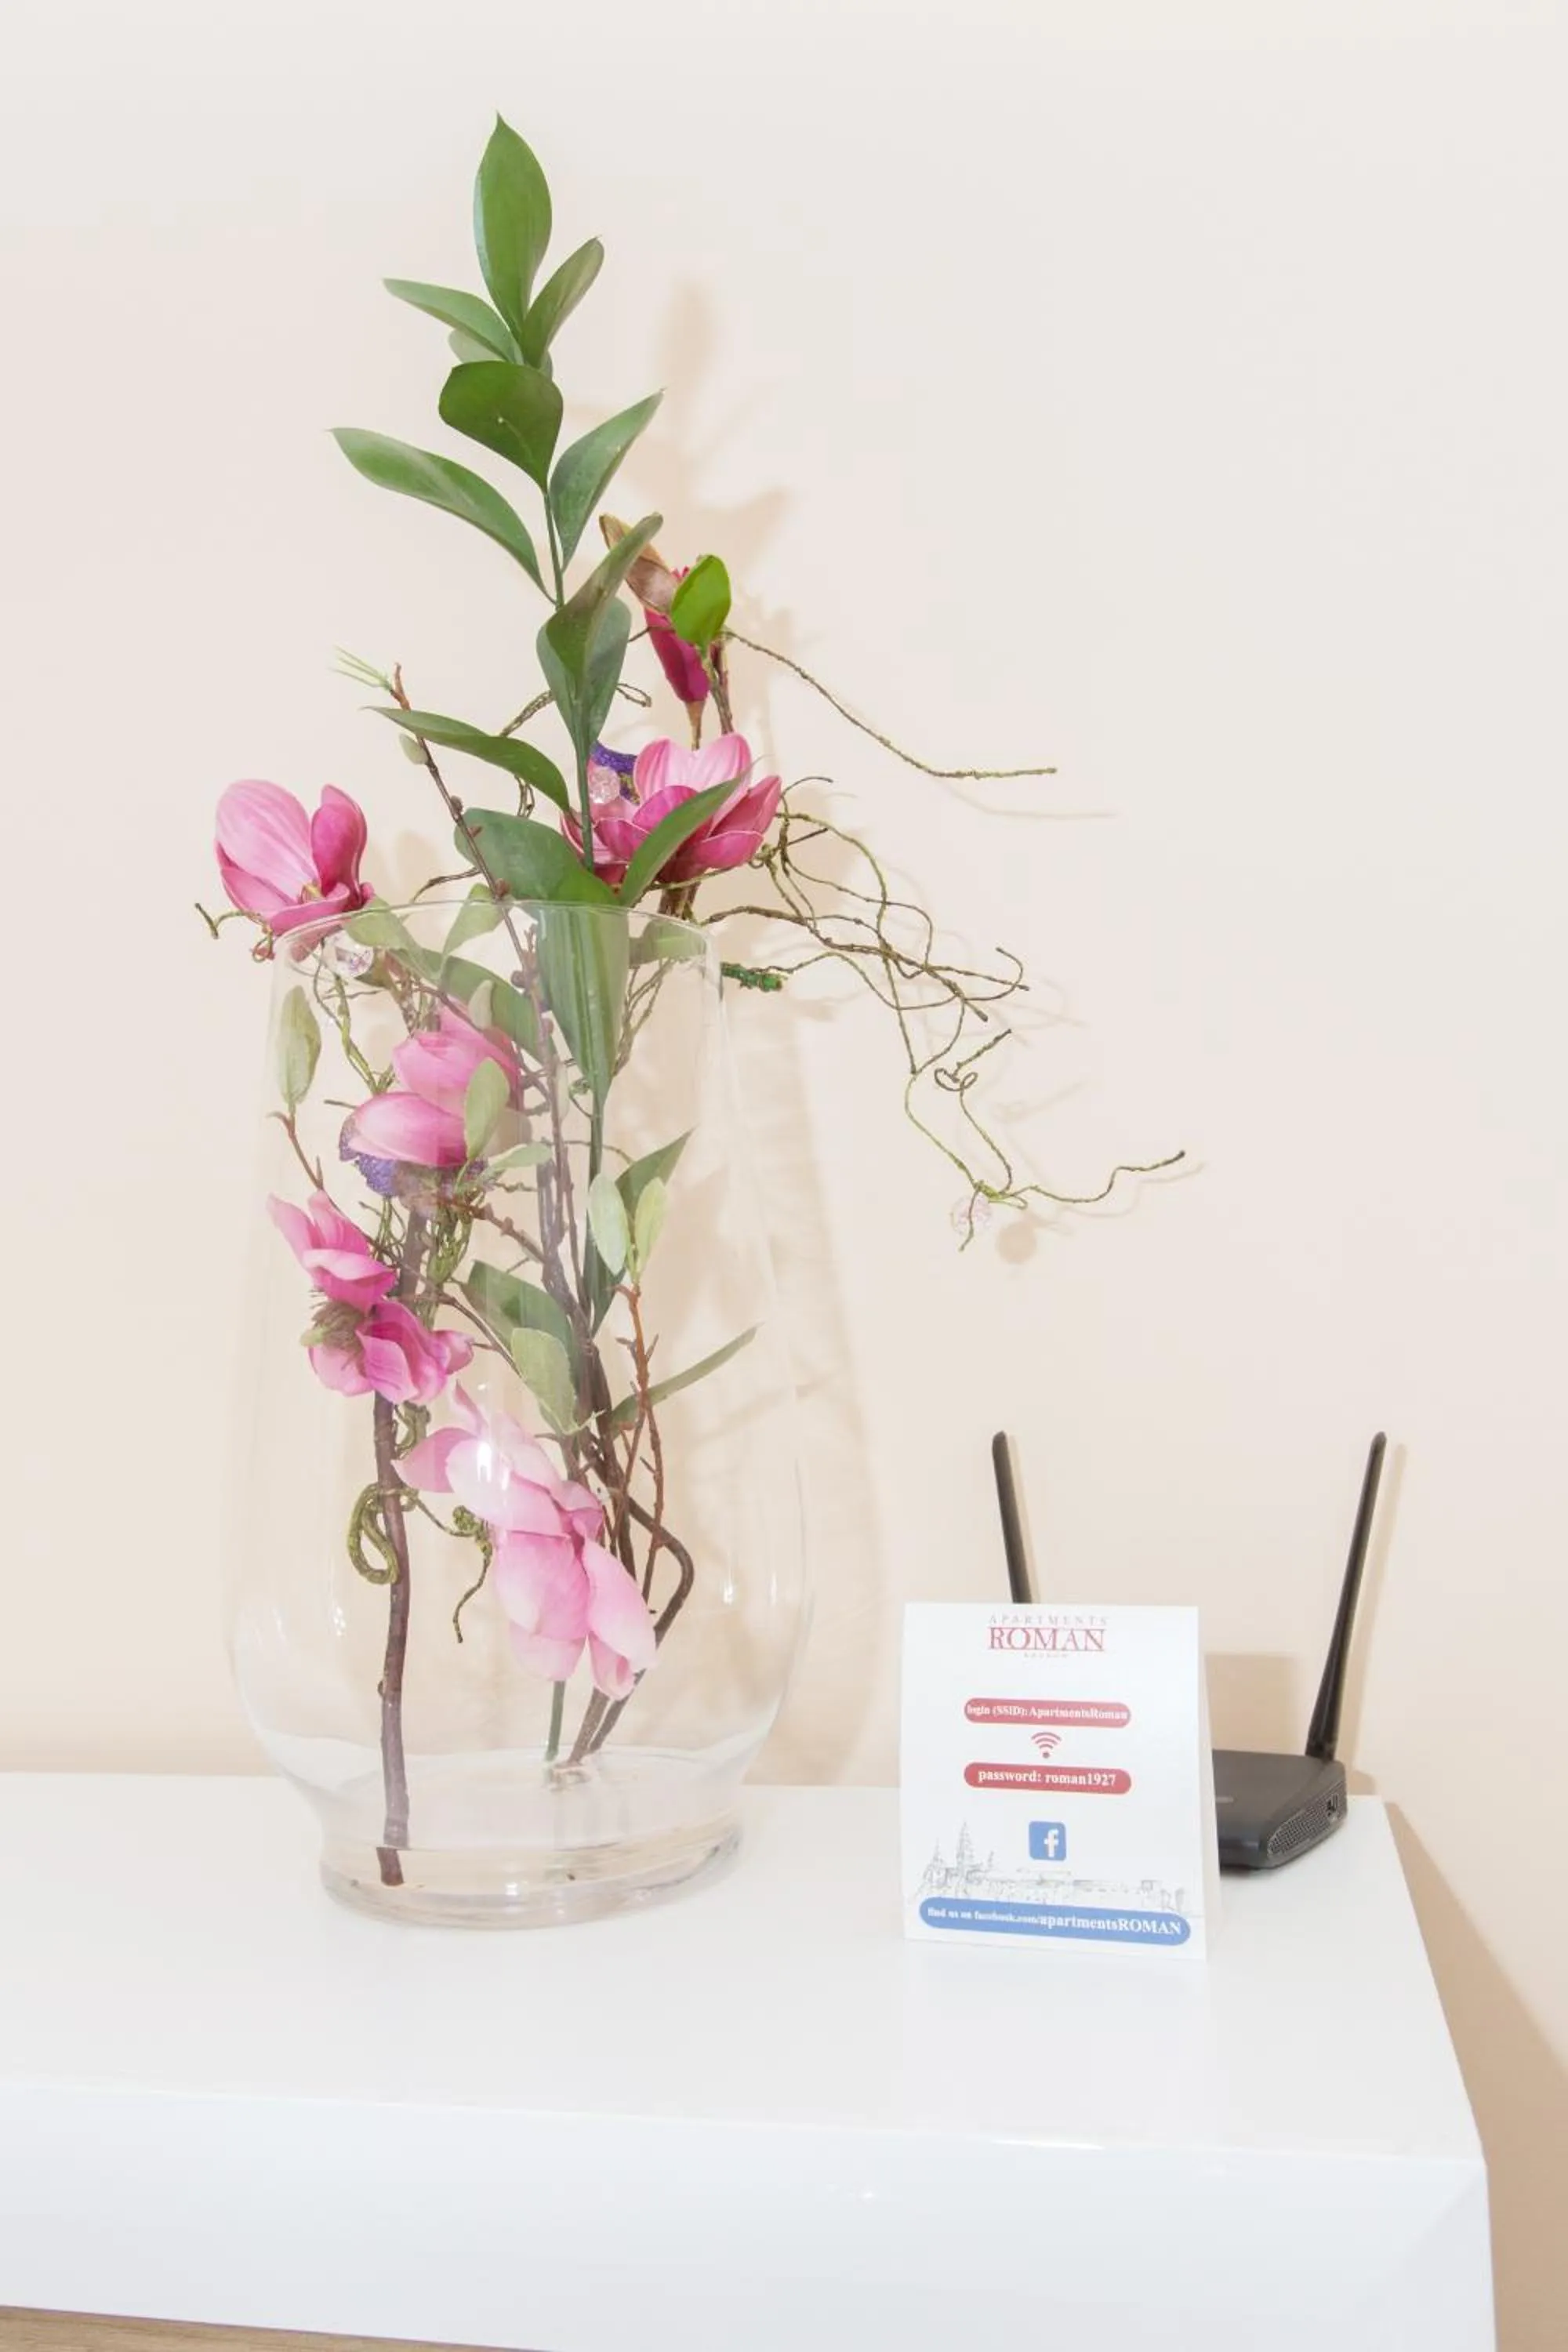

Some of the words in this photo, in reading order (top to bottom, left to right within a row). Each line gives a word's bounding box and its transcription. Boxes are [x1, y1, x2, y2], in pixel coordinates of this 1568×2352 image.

[989, 1613, 1109, 1626] APARTMENTS
[989, 1627, 1106, 1651] ROMAN
[967, 1704, 990, 1717] login
[1029, 1707, 1128, 1721] ApartmentsRoman
[978, 1769, 1042, 1784] password:
[1045, 1773, 1117, 1787] roman1927
[927, 1906, 946, 1918] find
[948, 1909, 959, 1918] us
[960, 1910, 972, 1919] on
